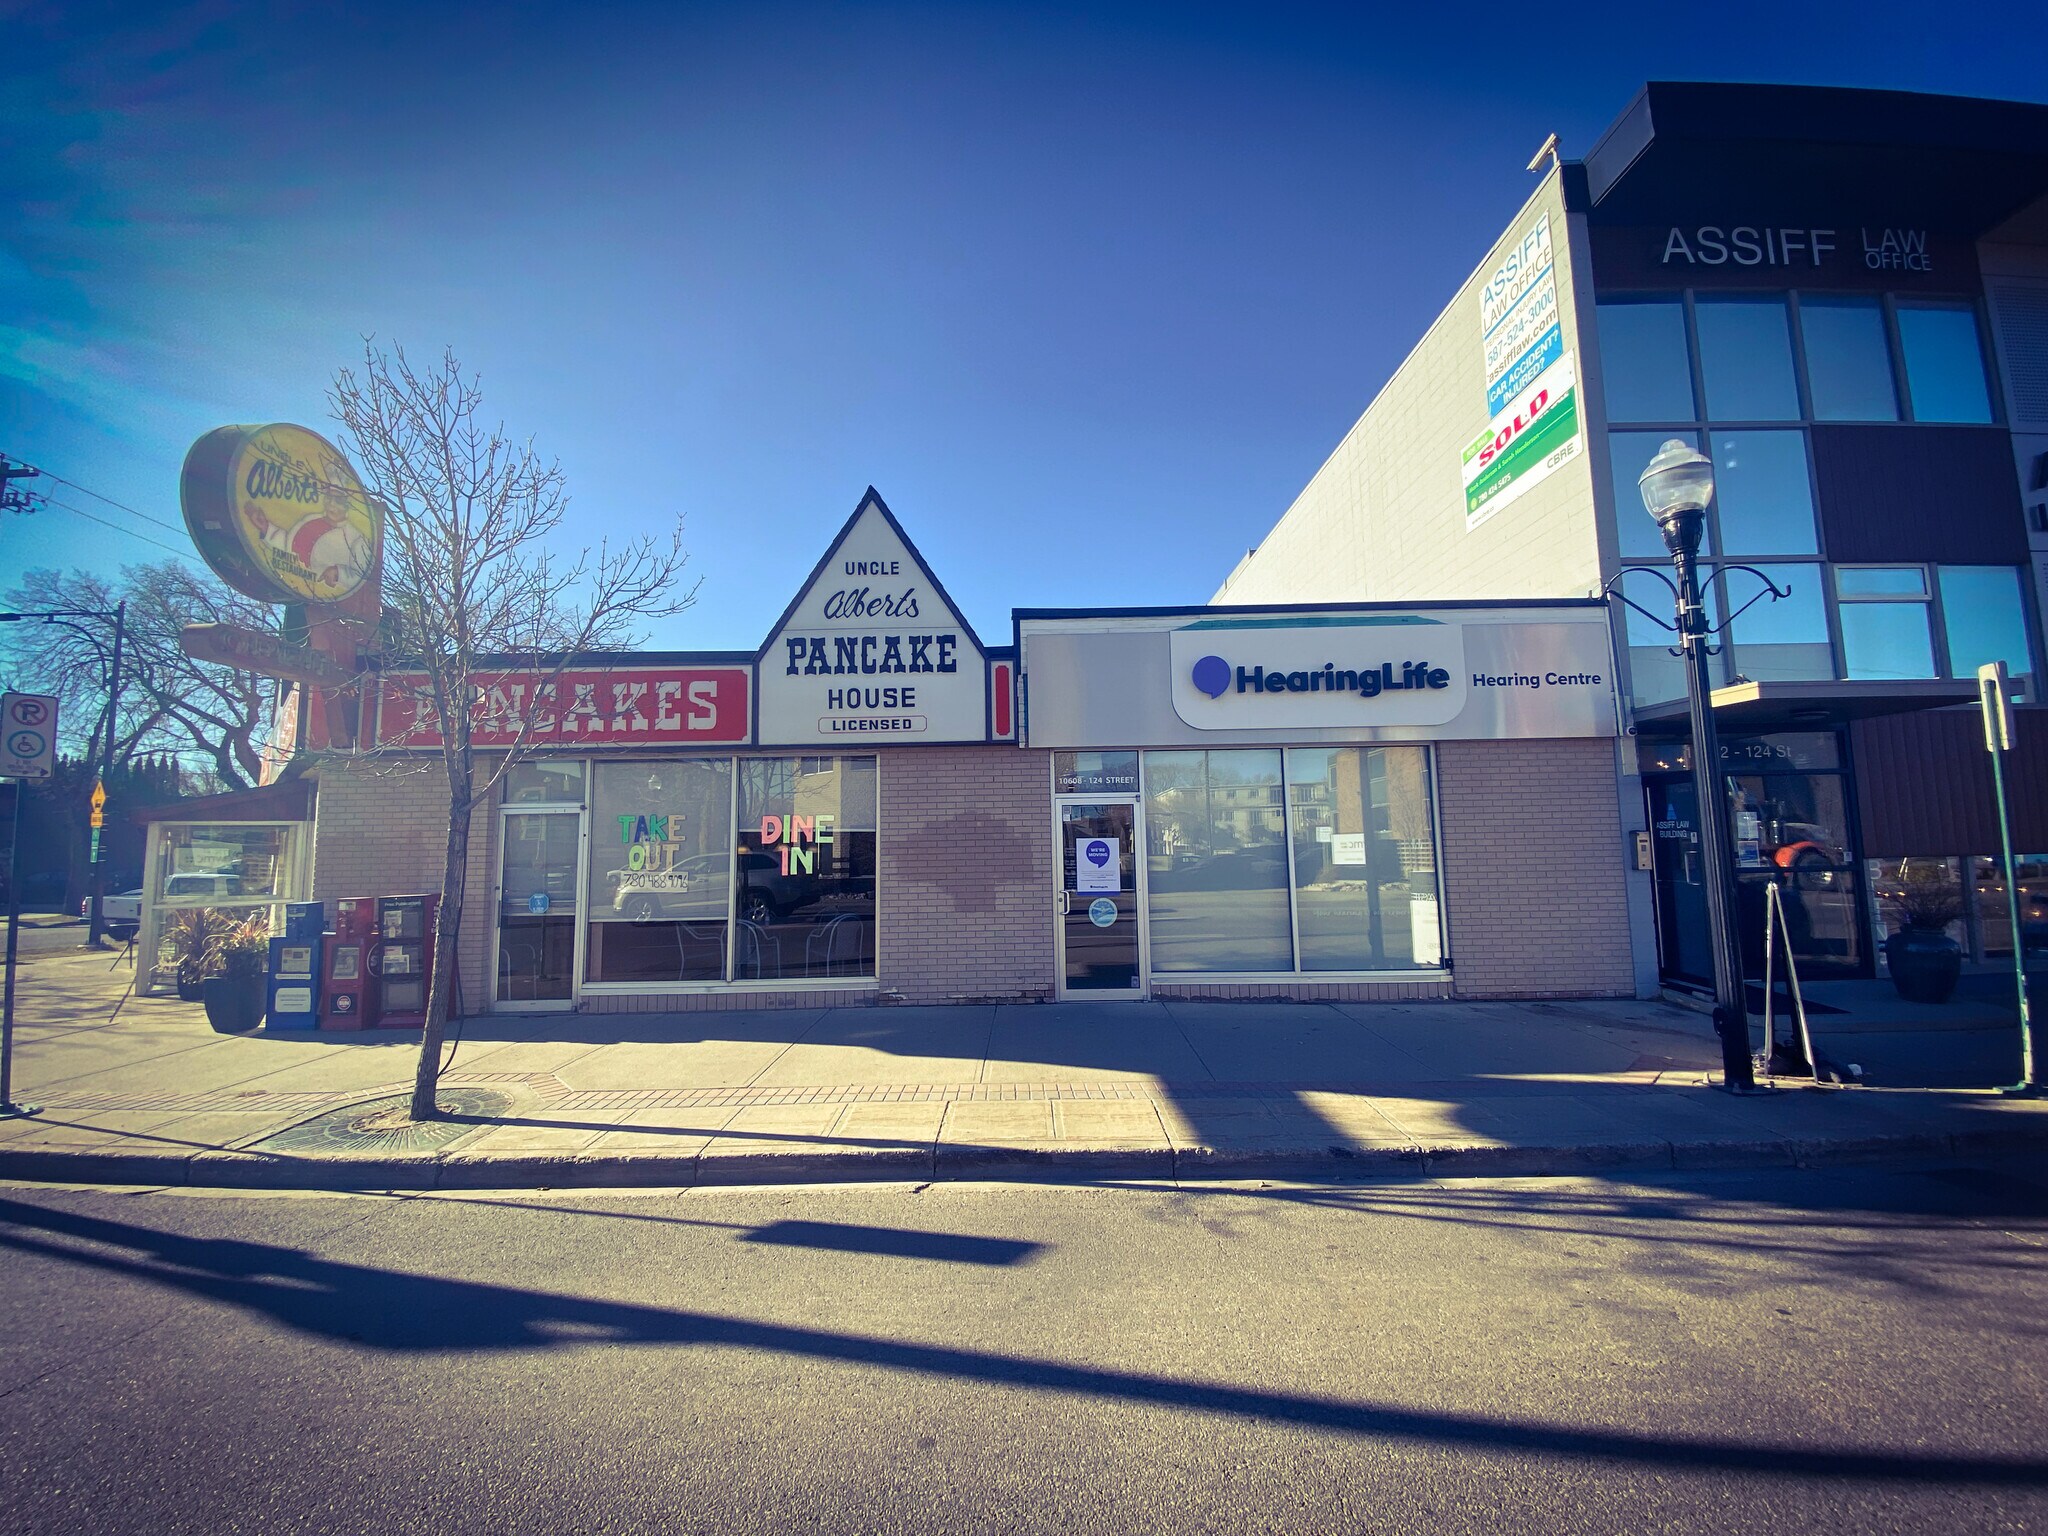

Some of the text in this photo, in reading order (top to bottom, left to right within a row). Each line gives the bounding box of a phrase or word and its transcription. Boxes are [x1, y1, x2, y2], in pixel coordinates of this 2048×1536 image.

[1662, 226, 1836, 266] ASSIFF
[1861, 227, 1926, 255] LAW
[1483, 214, 1547, 312] ASSIFF
[1865, 251, 1933, 271] OFFICE
[1483, 245, 1553, 332] LAW OFFICE
[1485, 274, 1553, 349] PERSONAL INJURY LAW
[1487, 287, 1554, 367] 587-524-3000
[1488, 309, 1557, 383] assifflaw.com
[1490, 329, 1559, 402] CAR ACCIDENT?
[1503, 357, 1545, 405] INJURED?
[1479, 388, 1548, 467] SOLD
[1466, 435, 1489, 458] FOR SALE
[1547, 443, 1574, 469] CBRE
[1477, 490, 1488, 504] 780
[845, 561, 900, 576] UNCLE
[823, 587, 920, 620] Alberts
[786, 634, 957, 676] PANCAKE
[1236, 661, 1450, 698] HearingLife
[1473, 672, 1601, 689] Hearing Centre
[828, 687, 916, 710] HOUSE
[832, 719, 912, 731] LICENSED
[1745, 745, 1772, 758] 124
[1776, 744, 1792, 758] St
[1059, 777, 1082, 785] 10608
[1106, 776, 1135, 784] STREET
[617, 814, 686, 843] TAKE
[761, 814, 834, 844] DINE
[1656, 820, 1689, 829] ASSIFF LAW
[1659, 830, 1687, 838] BUILDING
[629, 843, 680, 872] OUT
[779, 846, 813, 876] IN
[623, 873, 646, 888] 780
[648, 874, 667, 888] 488
